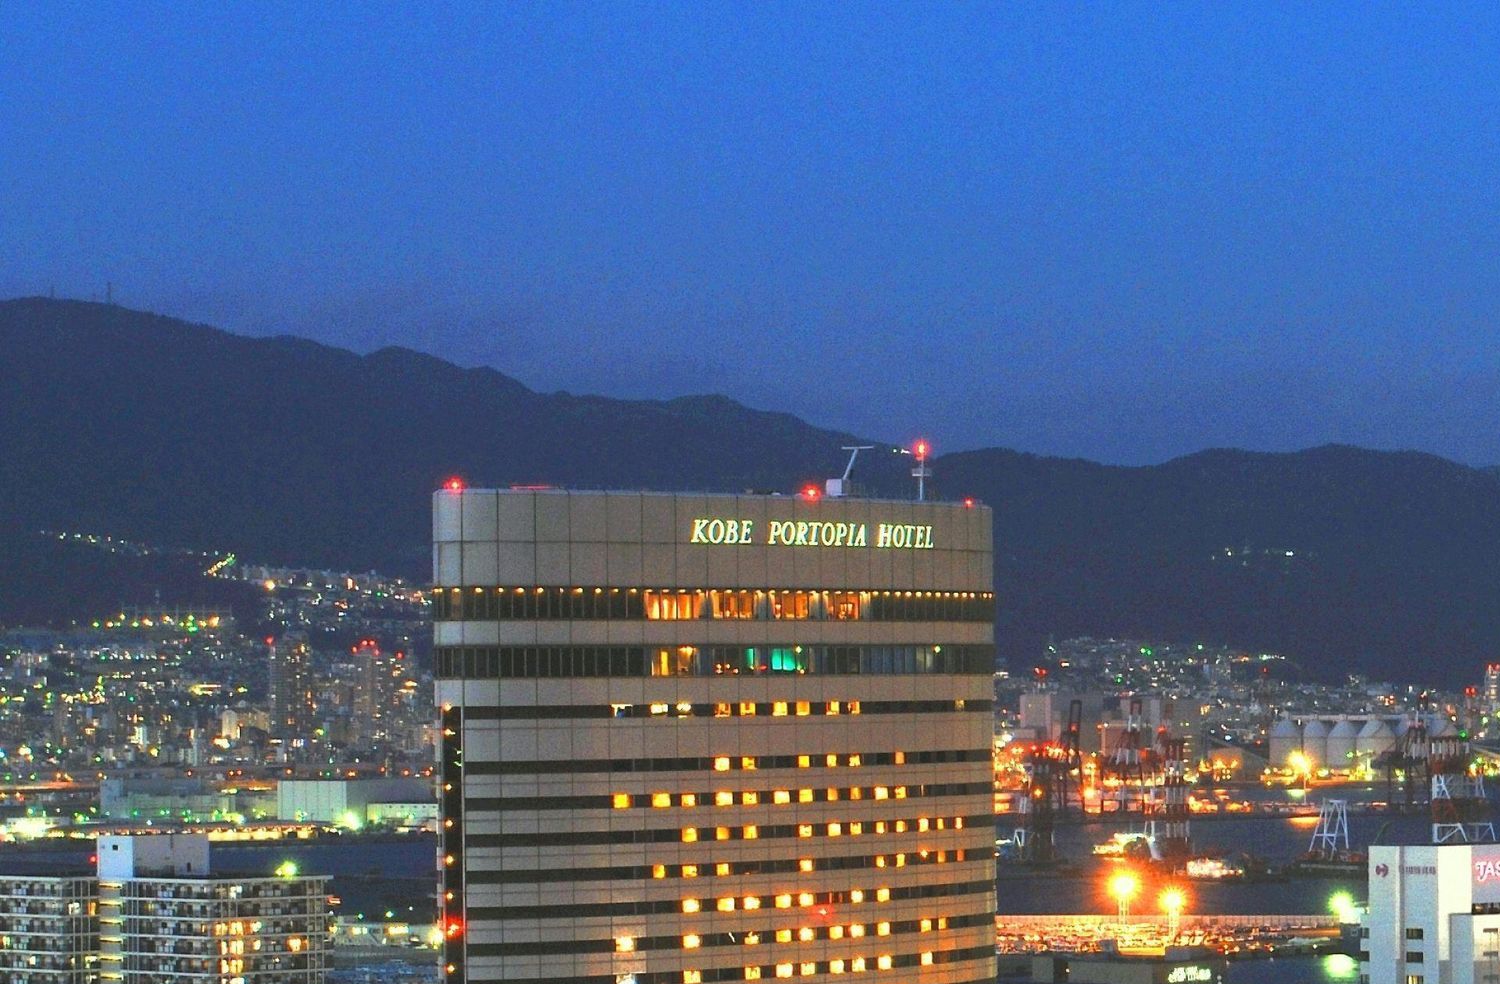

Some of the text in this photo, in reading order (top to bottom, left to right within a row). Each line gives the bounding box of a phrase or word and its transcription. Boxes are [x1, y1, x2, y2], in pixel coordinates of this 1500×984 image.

[690, 518, 934, 549] KOBE PORTOPIA HOTEL
